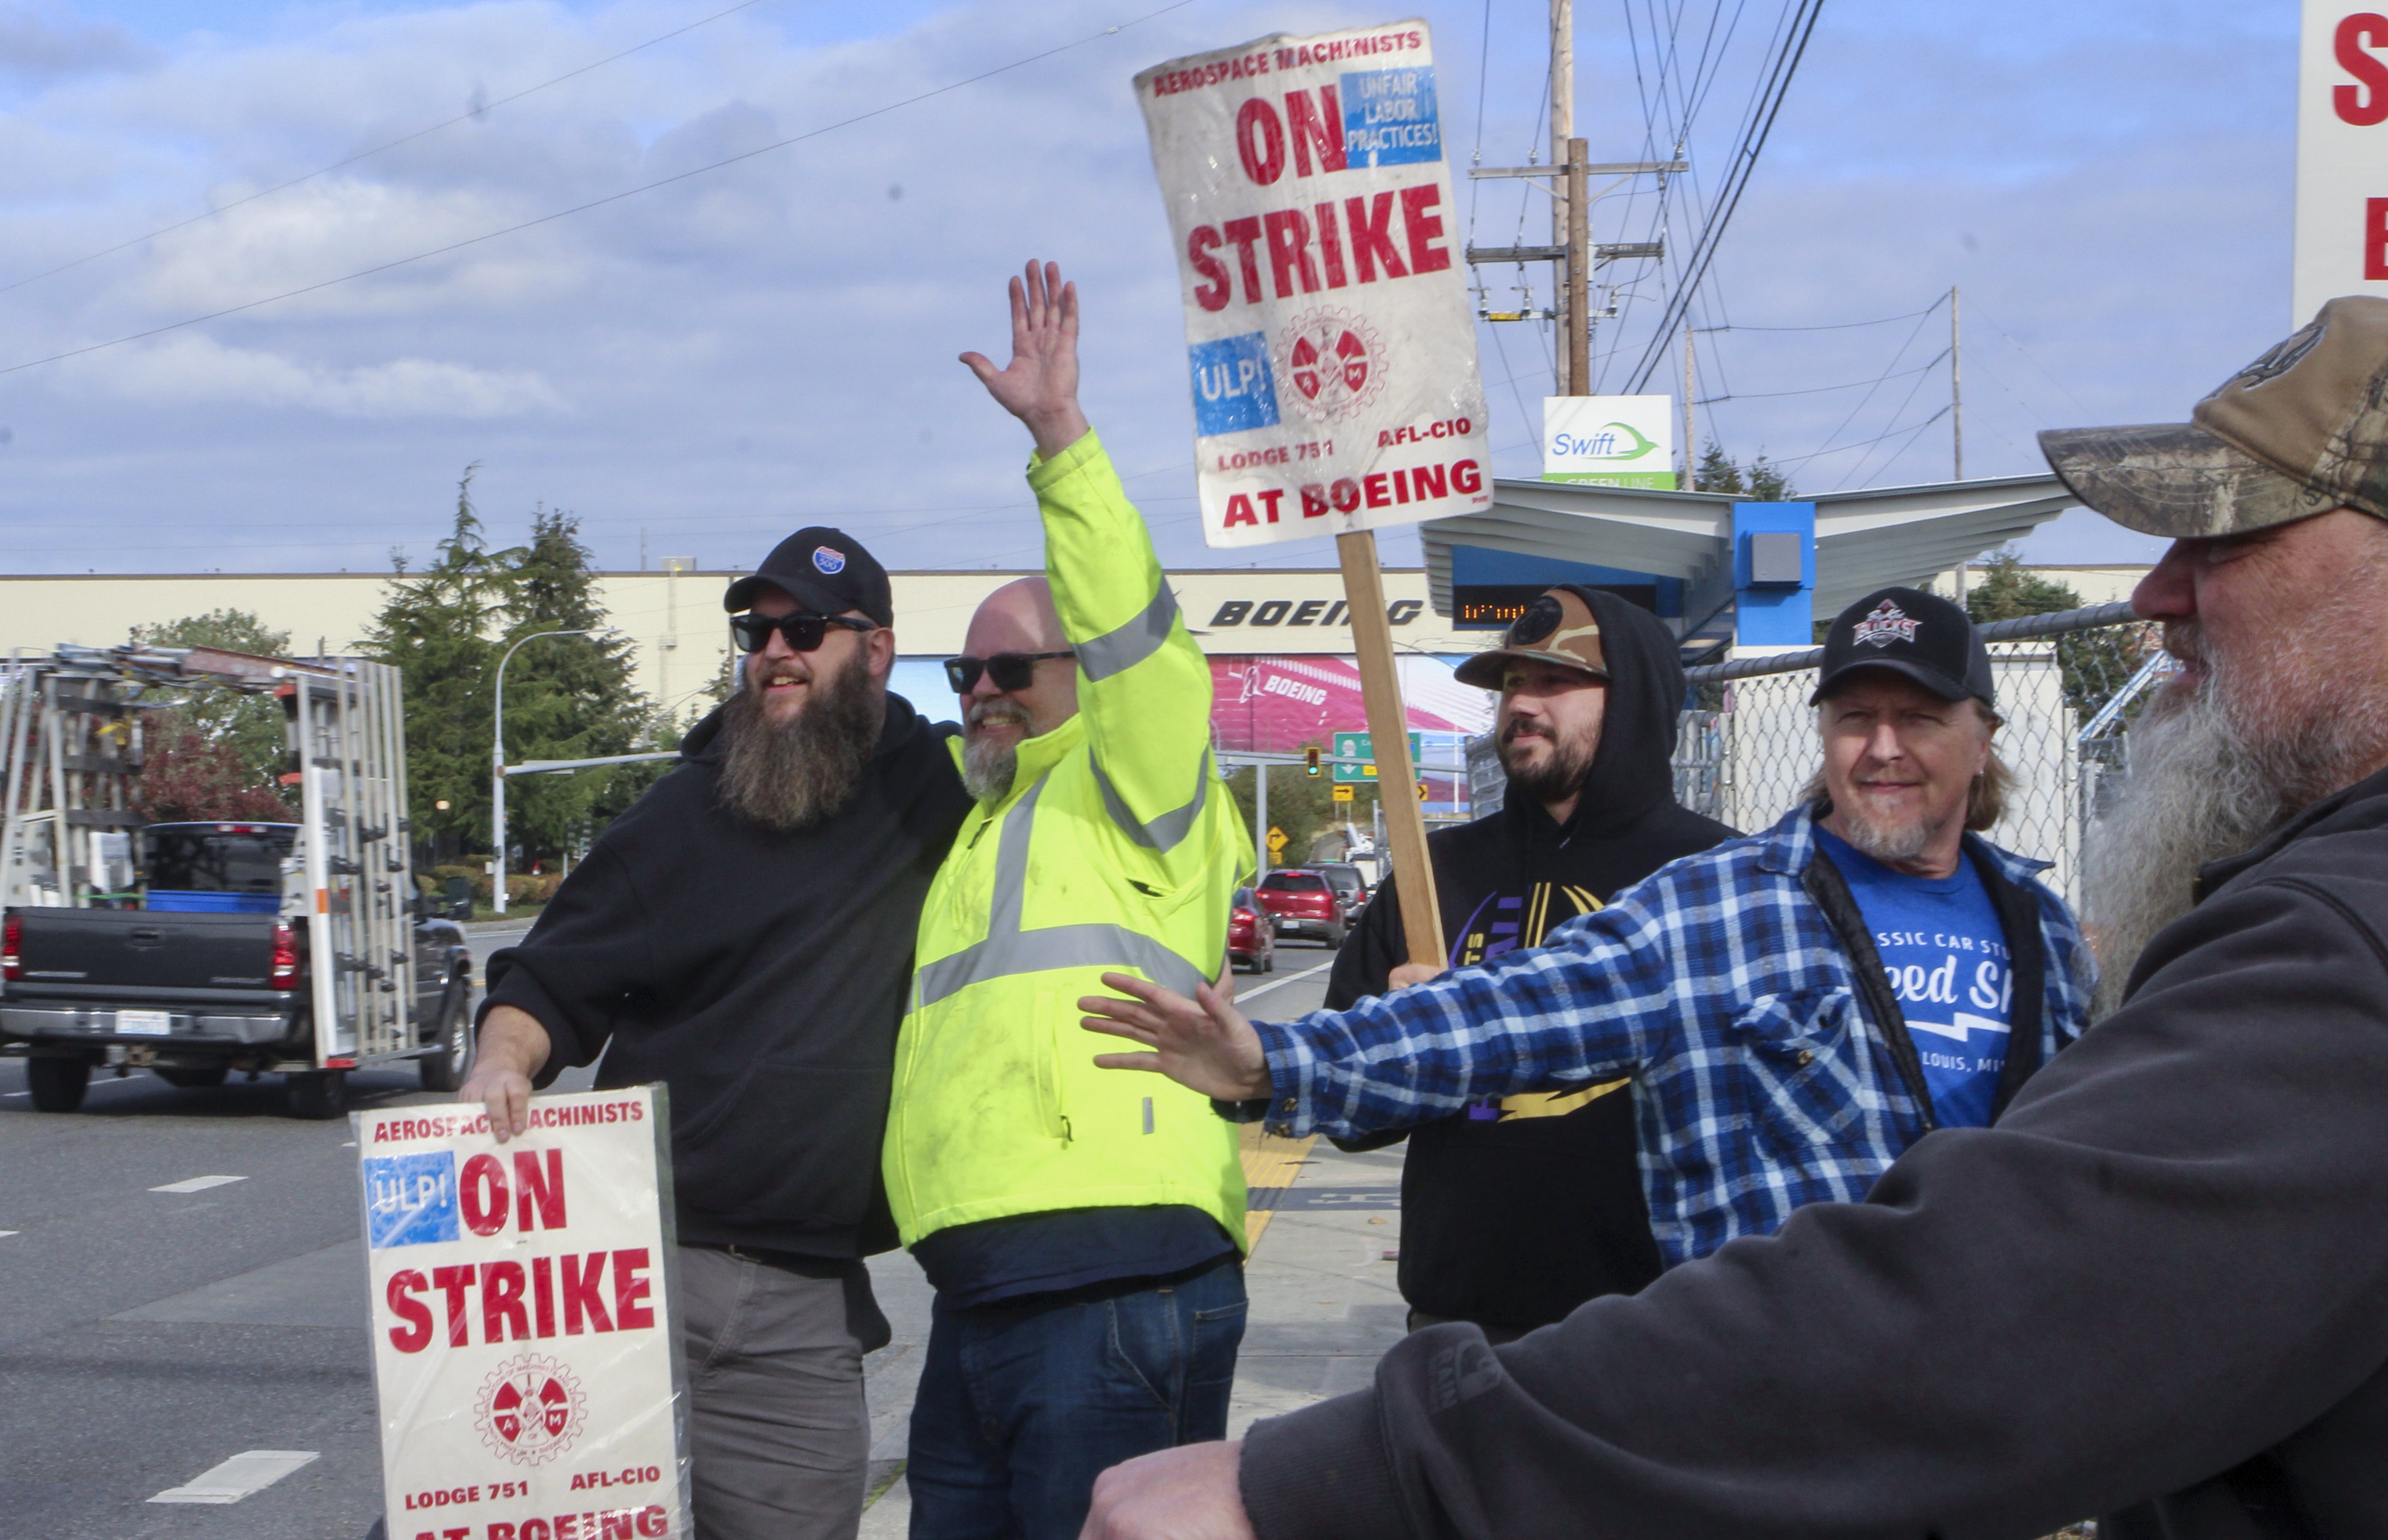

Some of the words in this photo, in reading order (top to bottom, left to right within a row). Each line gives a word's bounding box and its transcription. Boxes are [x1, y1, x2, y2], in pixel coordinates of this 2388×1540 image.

[1154, 53, 1270, 97] AEROSPACE
[1277, 31, 1421, 70] MACHINISTS
[1360, 72, 1418, 98] UNFAIR
[1364, 98, 1419, 125] LABOR
[1236, 84, 1348, 186] ON
[1348, 123, 1438, 152] PRACTICES!
[1188, 183, 1451, 311] STRIKE
[1200, 357, 1267, 401] ULP!
[1378, 417, 1471, 448] AFL-CIO
[1552, 433, 1615, 456] Swift
[1218, 447, 1289, 473] LODGE
[1296, 441, 1333, 459] 751
[1223, 488, 1284, 529] AT
[1300, 458, 1482, 519] BOEING
[1209, 600, 1424, 627] BOEIG
[1262, 675, 1328, 706] BOEING
[1935, 933, 1974, 951] CAR
[1922, 1051, 1972, 1072] LOUIS,
[375, 1112, 496, 1143] AEROSPAC
[527, 1101, 644, 1128] ACHINISTS
[375, 1172, 448, 1214] ULP!
[459, 1148, 567, 1237] ON
[387, 1247, 655, 1354] STRIKE
[570, 1466, 660, 1491] AFL-CIO
[405, 1486, 480, 1510] LODGE
[488, 1480, 529, 1500] 751
